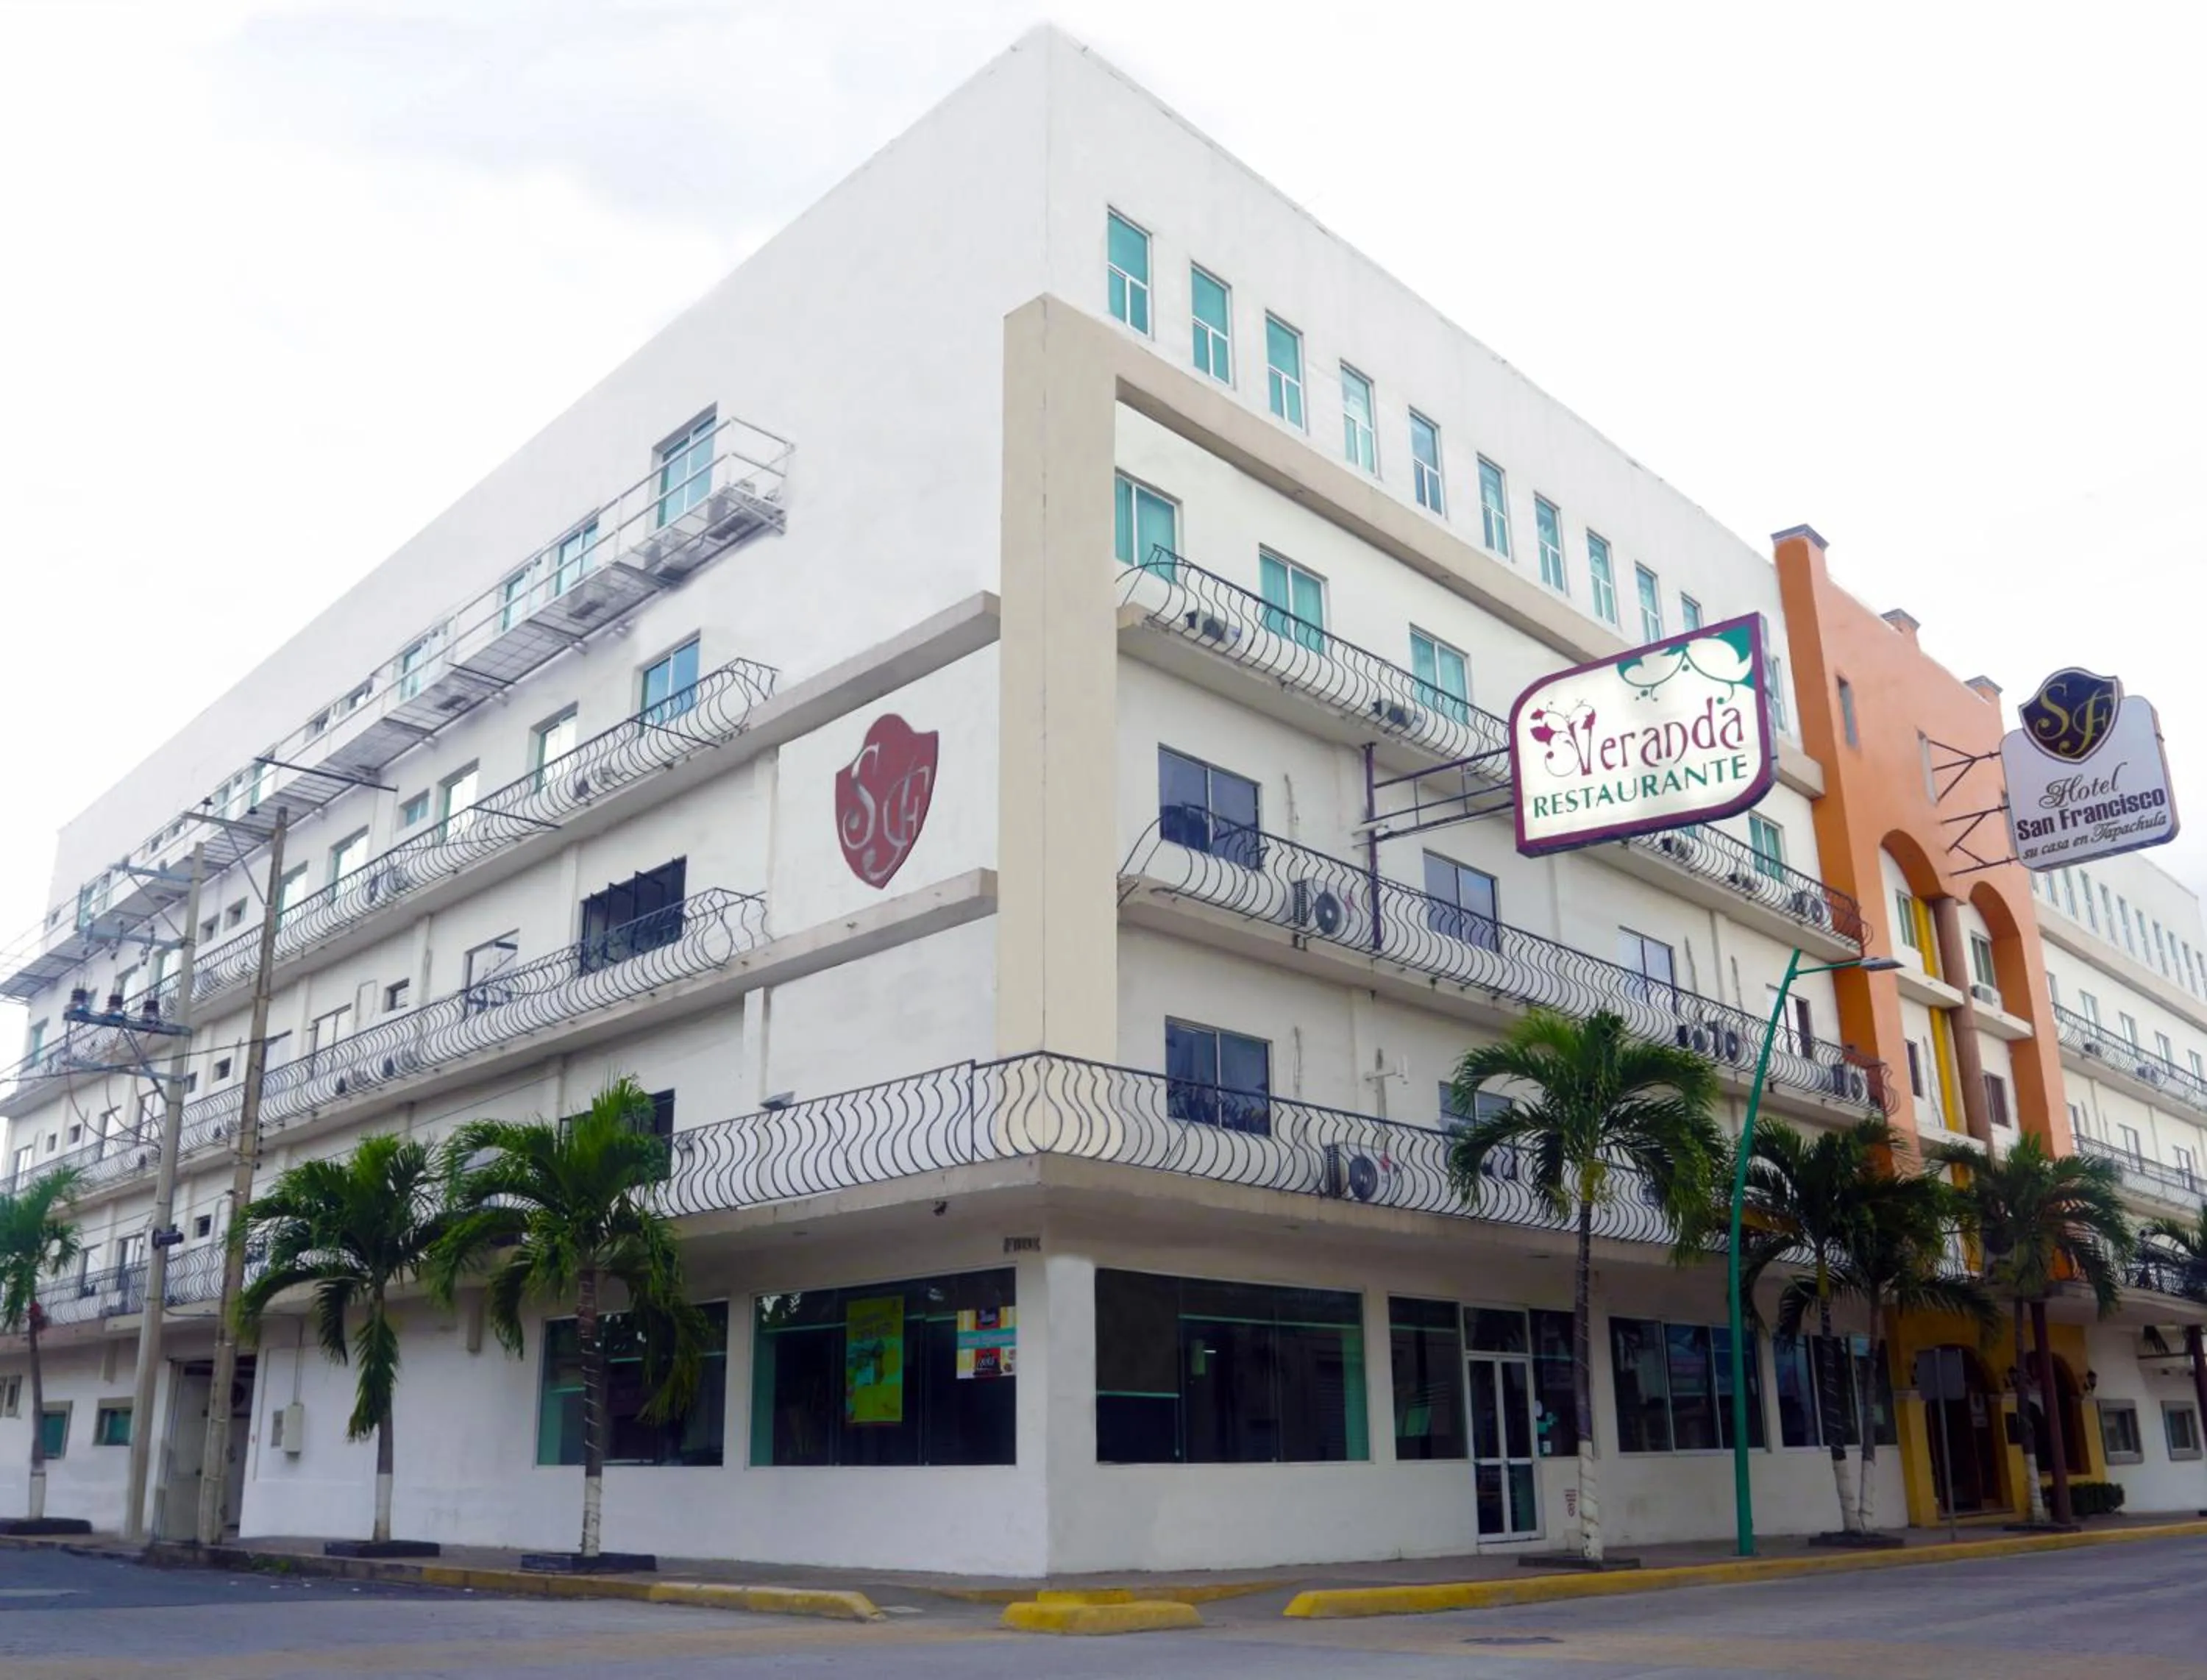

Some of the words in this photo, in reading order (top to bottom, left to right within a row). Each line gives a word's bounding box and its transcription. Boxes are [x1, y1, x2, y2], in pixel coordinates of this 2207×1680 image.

[1543, 697, 1744, 777] Veranda
[1532, 754, 1748, 819] RESTAURANTE
[2039, 761, 2128, 809] Hotel
[2016, 816, 2055, 841] San
[2058, 788, 2166, 830] Francisco
[2023, 847, 2039, 860] su
[2041, 839, 2069, 854] casa
[2072, 835, 2089, 847] en
[2090, 810, 2167, 843] Tapachula
